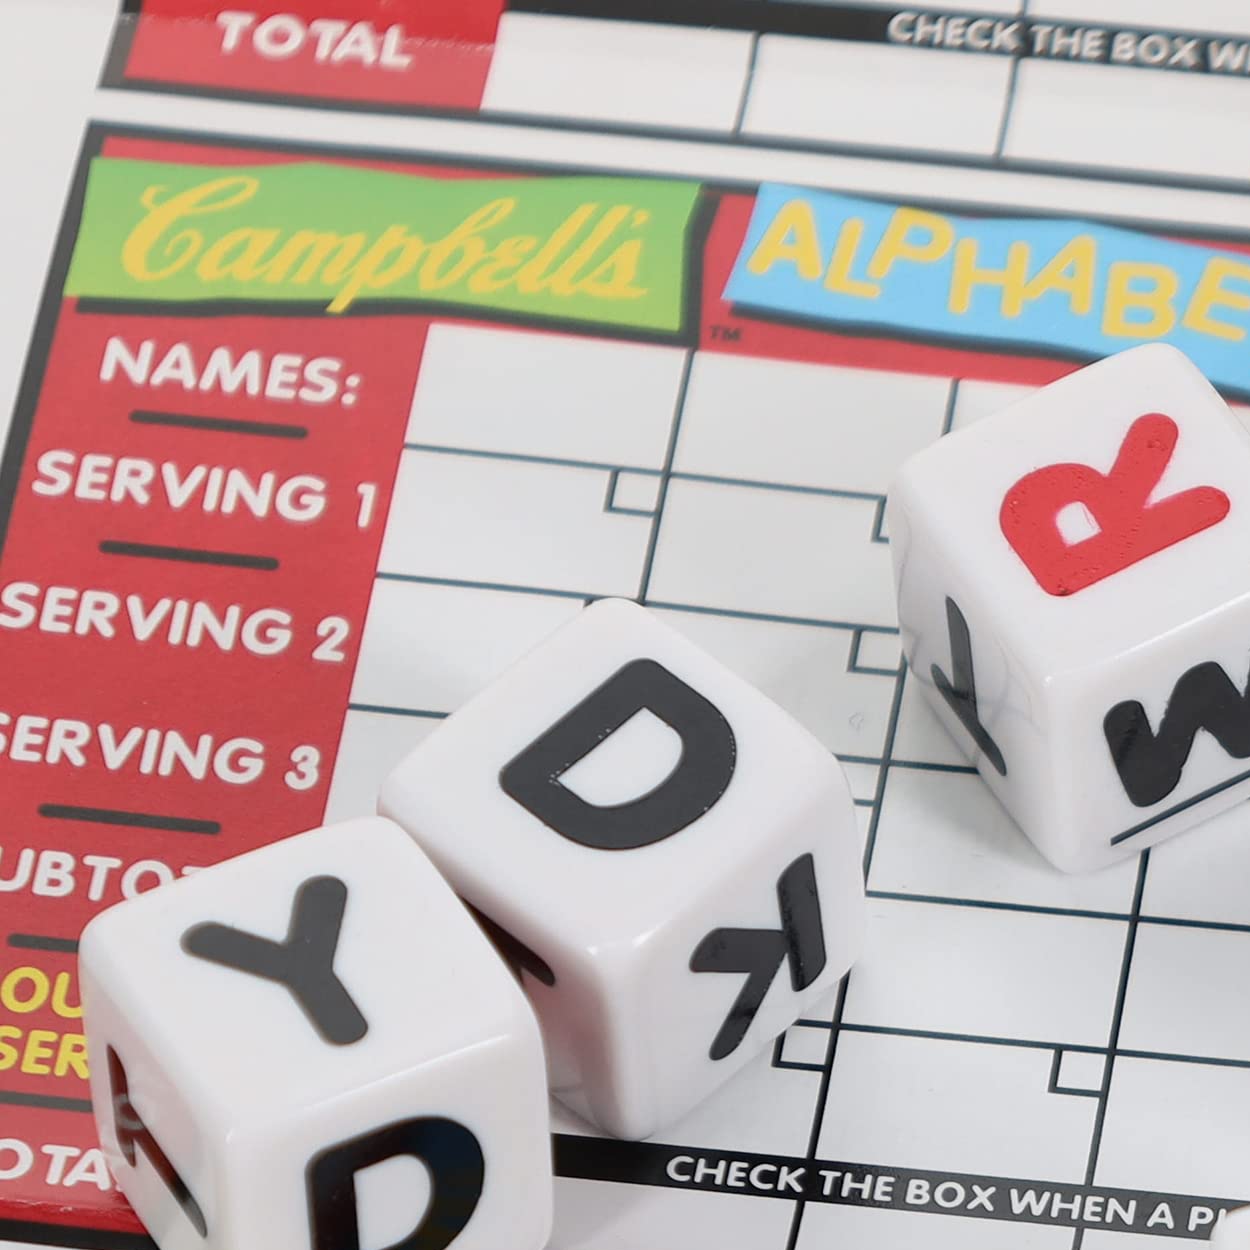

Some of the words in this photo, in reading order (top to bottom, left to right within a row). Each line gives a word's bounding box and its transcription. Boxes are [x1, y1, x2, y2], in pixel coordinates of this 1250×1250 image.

[215, 11, 412, 69] TOTAL
[887, 10, 1021, 53] CHECK
[1031, 23, 1104, 60] THE
[1111, 31, 1198, 69] BOX
[121, 175, 649, 314] Campbell's
[101, 337, 363, 406] NAMES:
[32, 449, 328, 523] SERVING
[356, 482, 379, 529] 1
[999, 412, 1231, 597] R
[0, 581, 293, 656] SERVING
[311, 615, 350, 662] 2
[284, 744, 321, 790] 3
[499, 658, 737, 850] D
[0, 848, 200, 901] UBTO
[180, 875, 369, 1046] Y
[665, 1155, 806, 1193] CHECK
[818, 1169, 894, 1202] THE
[904, 1179, 998, 1212] BOX
[1009, 1187, 1136, 1227] WHEN
[1146, 1202, 1176, 1229] A
